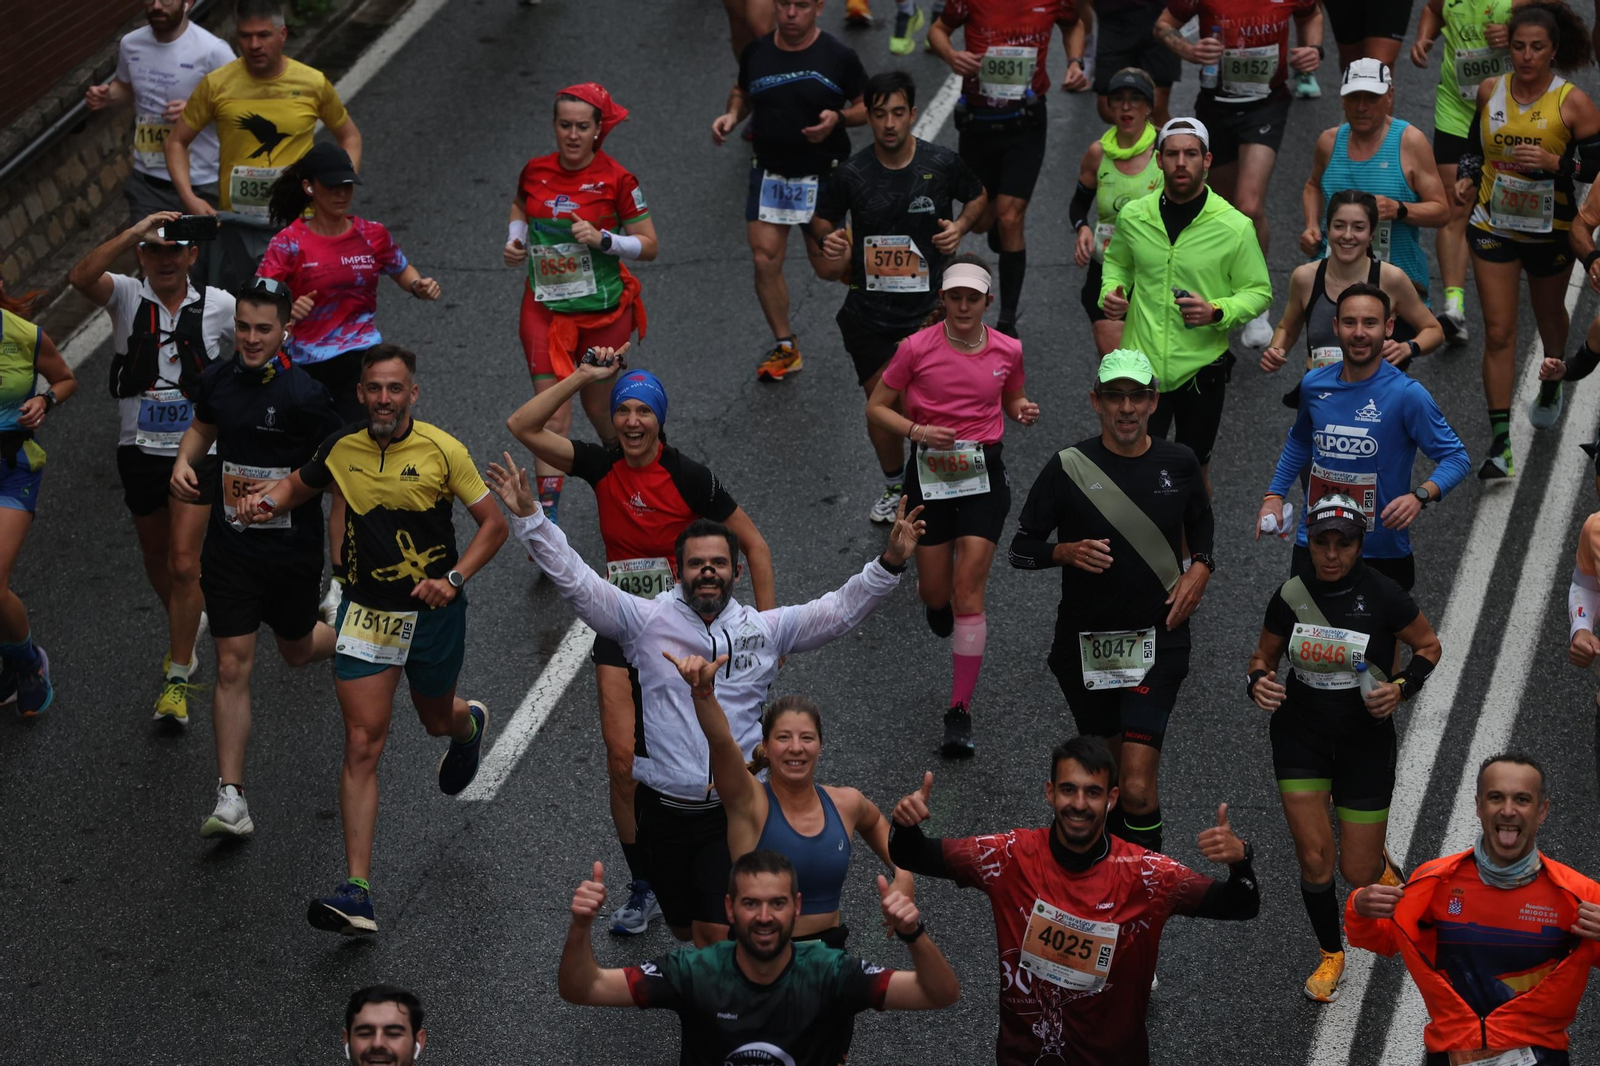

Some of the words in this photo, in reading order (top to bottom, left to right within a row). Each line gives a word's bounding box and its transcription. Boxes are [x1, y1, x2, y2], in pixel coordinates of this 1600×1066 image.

[988, 60, 1023, 76] 9831
[1232, 60, 1269, 75] 8152
[1463, 58, 1500, 77] 6960
[1501, 189, 1540, 210] 7875
[874, 250, 912, 267] 5767
[147, 404, 189, 423] 1792
[927, 455, 969, 473] 9185
[353, 608, 404, 636] 15112
[1092, 639, 1137, 660] 8047
[1299, 640, 1347, 665] 8046
[1038, 925, 1094, 960] 4025
